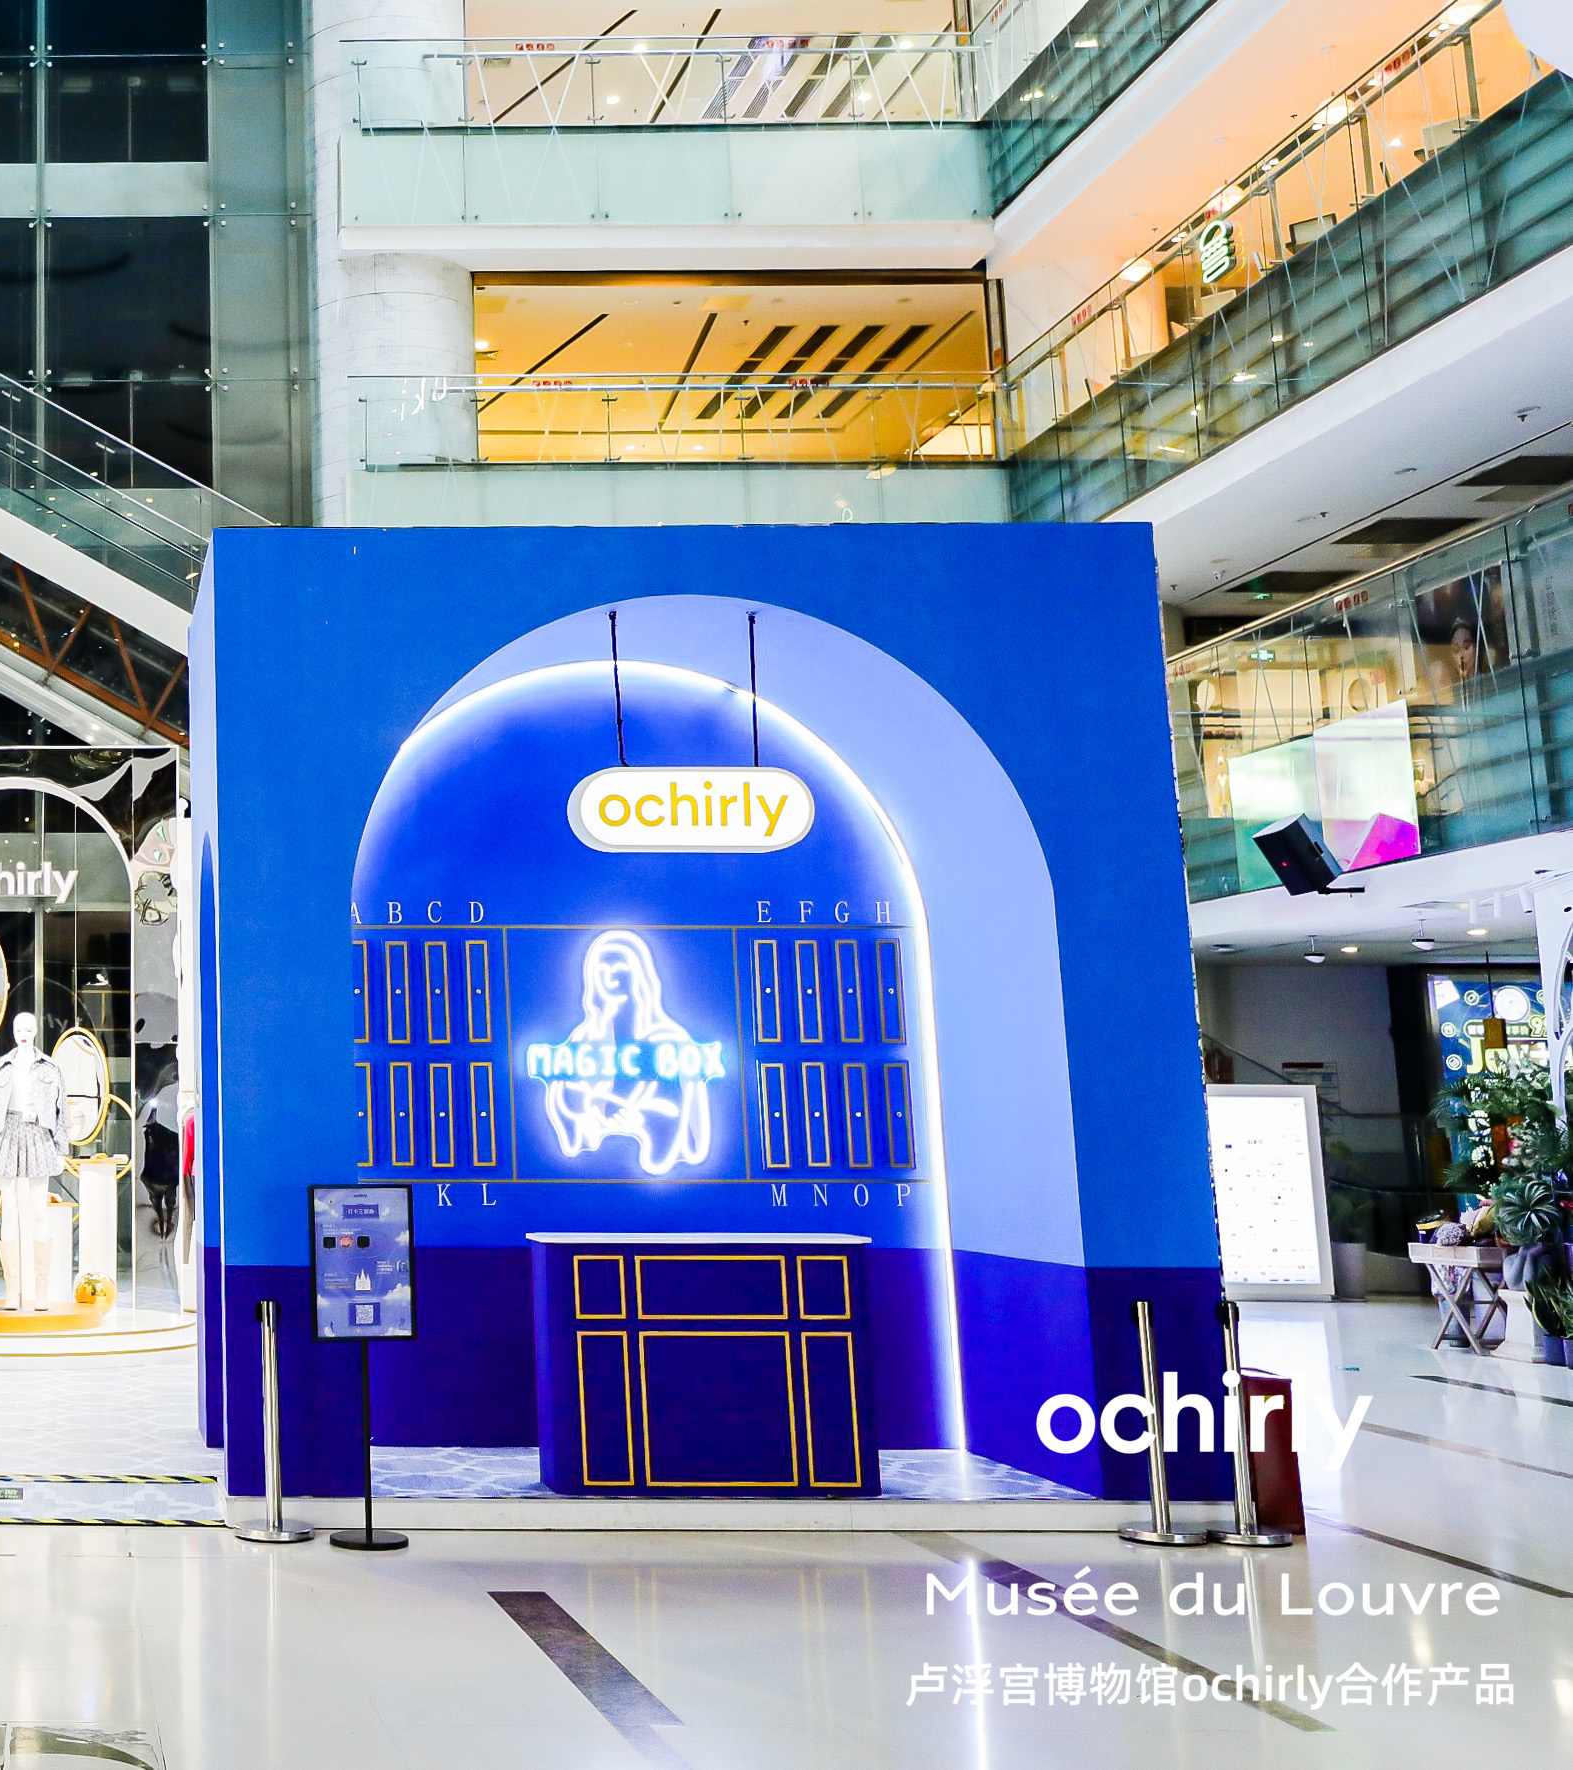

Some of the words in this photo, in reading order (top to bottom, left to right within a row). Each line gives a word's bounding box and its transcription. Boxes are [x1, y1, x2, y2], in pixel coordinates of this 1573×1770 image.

[599, 781, 789, 837] ochirly
[350, 901, 362, 924] A
[387, 901, 403, 924] B
[427, 901, 442, 924] C
[469, 901, 484, 924] D
[756, 900, 772, 923] E
[799, 900, 814, 923] F
[834, 900, 850, 924] G
[875, 901, 892, 924] H
[528, 1044, 641, 1077] MAGIC
[658, 1041, 726, 1079] BOX
[436, 1183, 453, 1207] K
[481, 1182, 497, 1206] L
[771, 1183, 789, 1207] M
[812, 1183, 828, 1207] N
[853, 1183, 869, 1207] O
[895, 1183, 911, 1207] P
